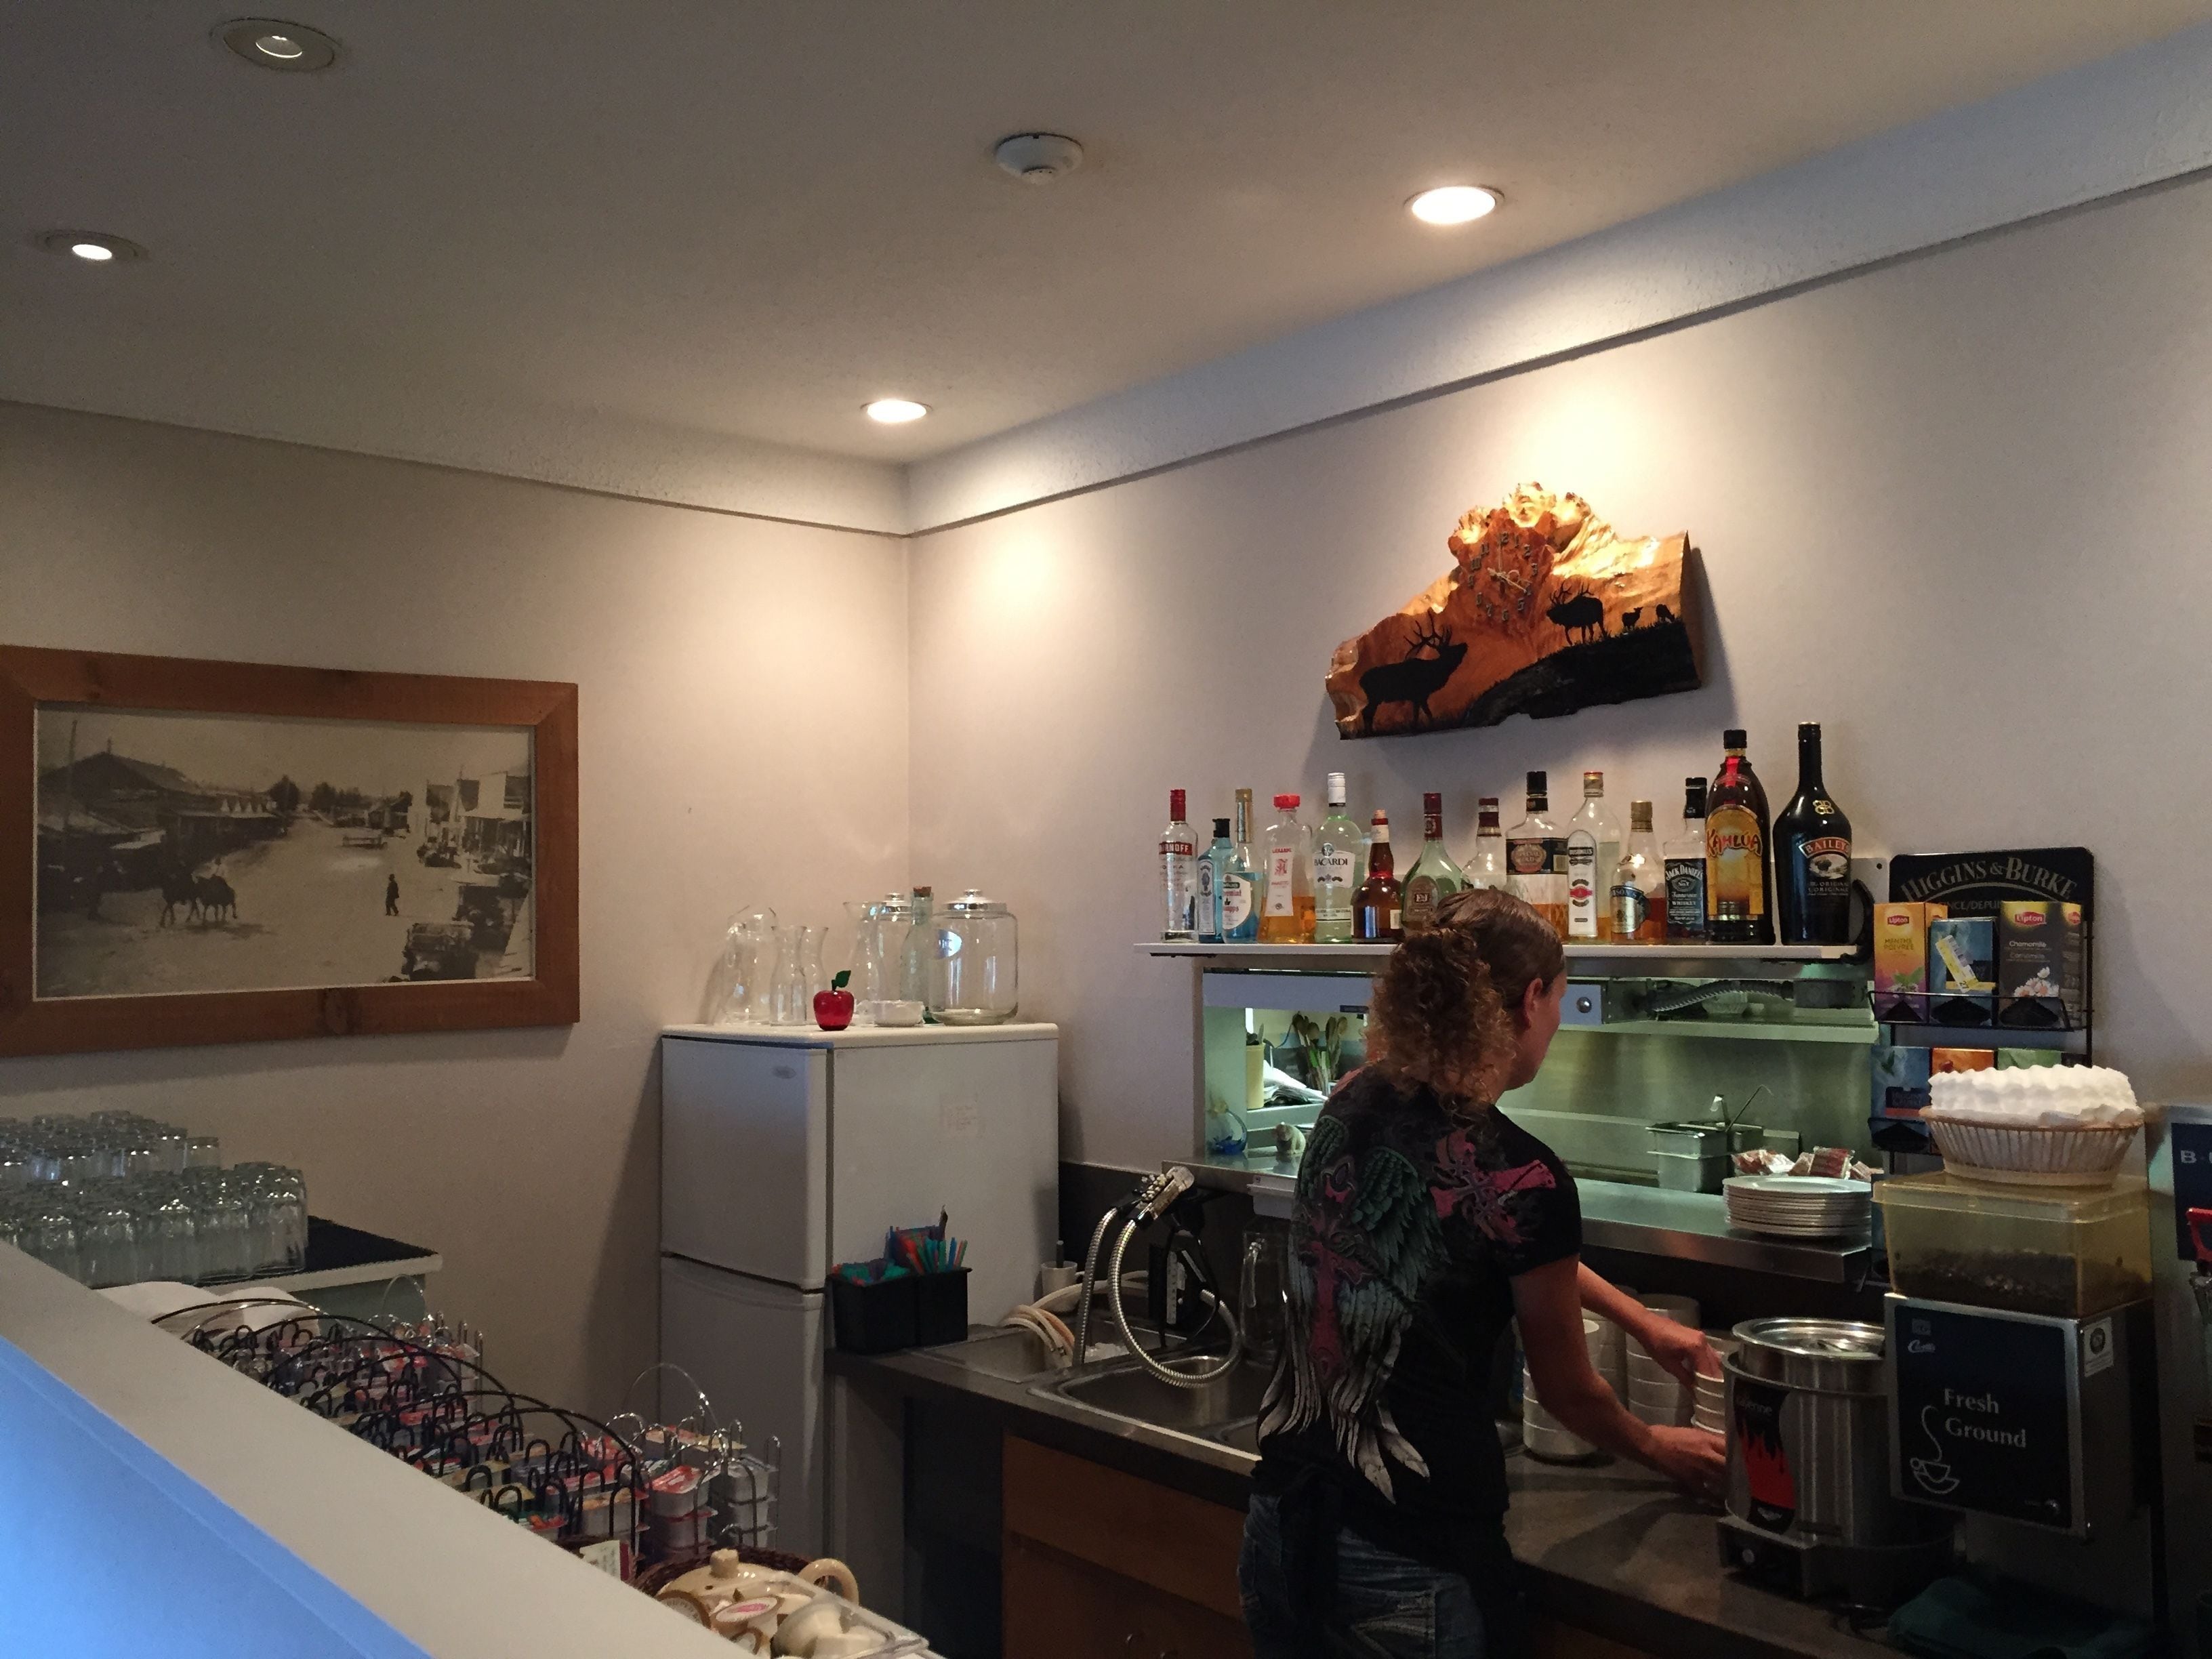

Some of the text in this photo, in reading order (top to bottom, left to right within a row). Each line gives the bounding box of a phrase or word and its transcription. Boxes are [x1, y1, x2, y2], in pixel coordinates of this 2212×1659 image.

[1314, 858, 1348, 866] BACARDI
[1900, 857, 2077, 901] HIGGINS & BURKE
[1888, 916, 1909, 925] Lipton
[2016, 913, 2043, 925] Lipton
[1944, 1388, 1999, 1414] Fresh
[1945, 1417, 2026, 1448] Ground
